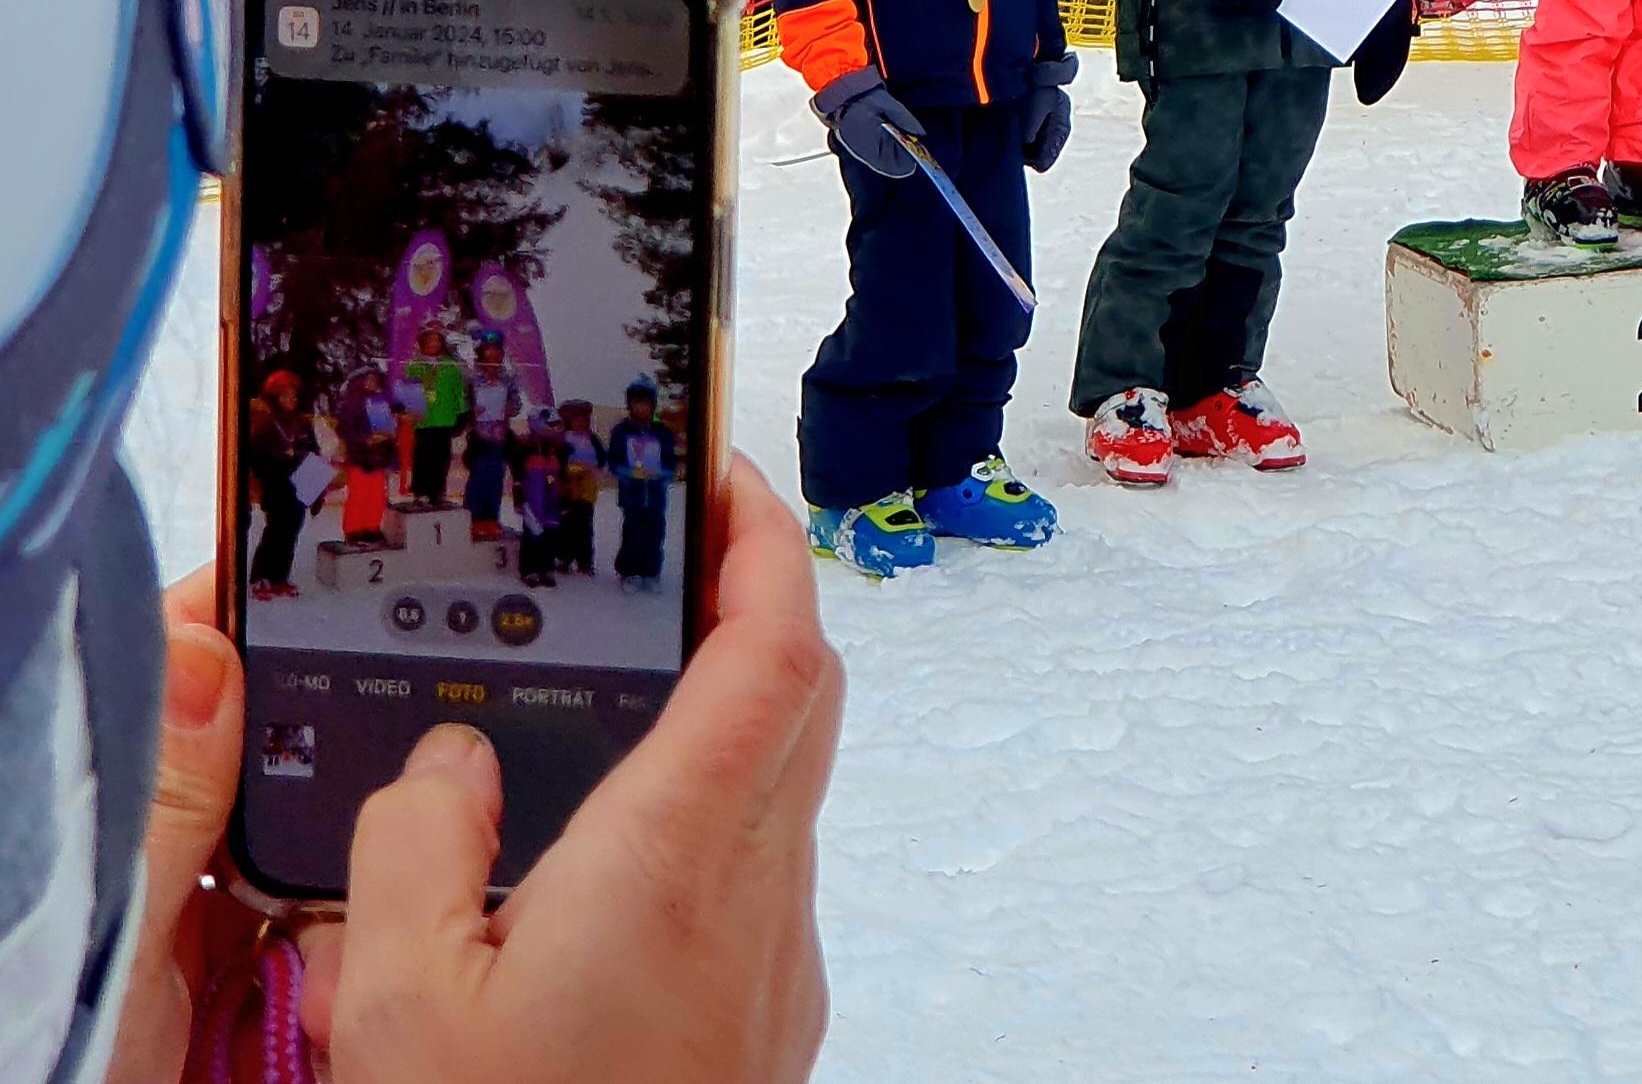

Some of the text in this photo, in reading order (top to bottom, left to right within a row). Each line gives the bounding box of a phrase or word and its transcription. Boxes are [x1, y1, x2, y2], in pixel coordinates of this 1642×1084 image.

[287, 22, 309, 42] 14
[355, 678, 411, 696] VIDEO
[436, 681, 486, 702] FOTO
